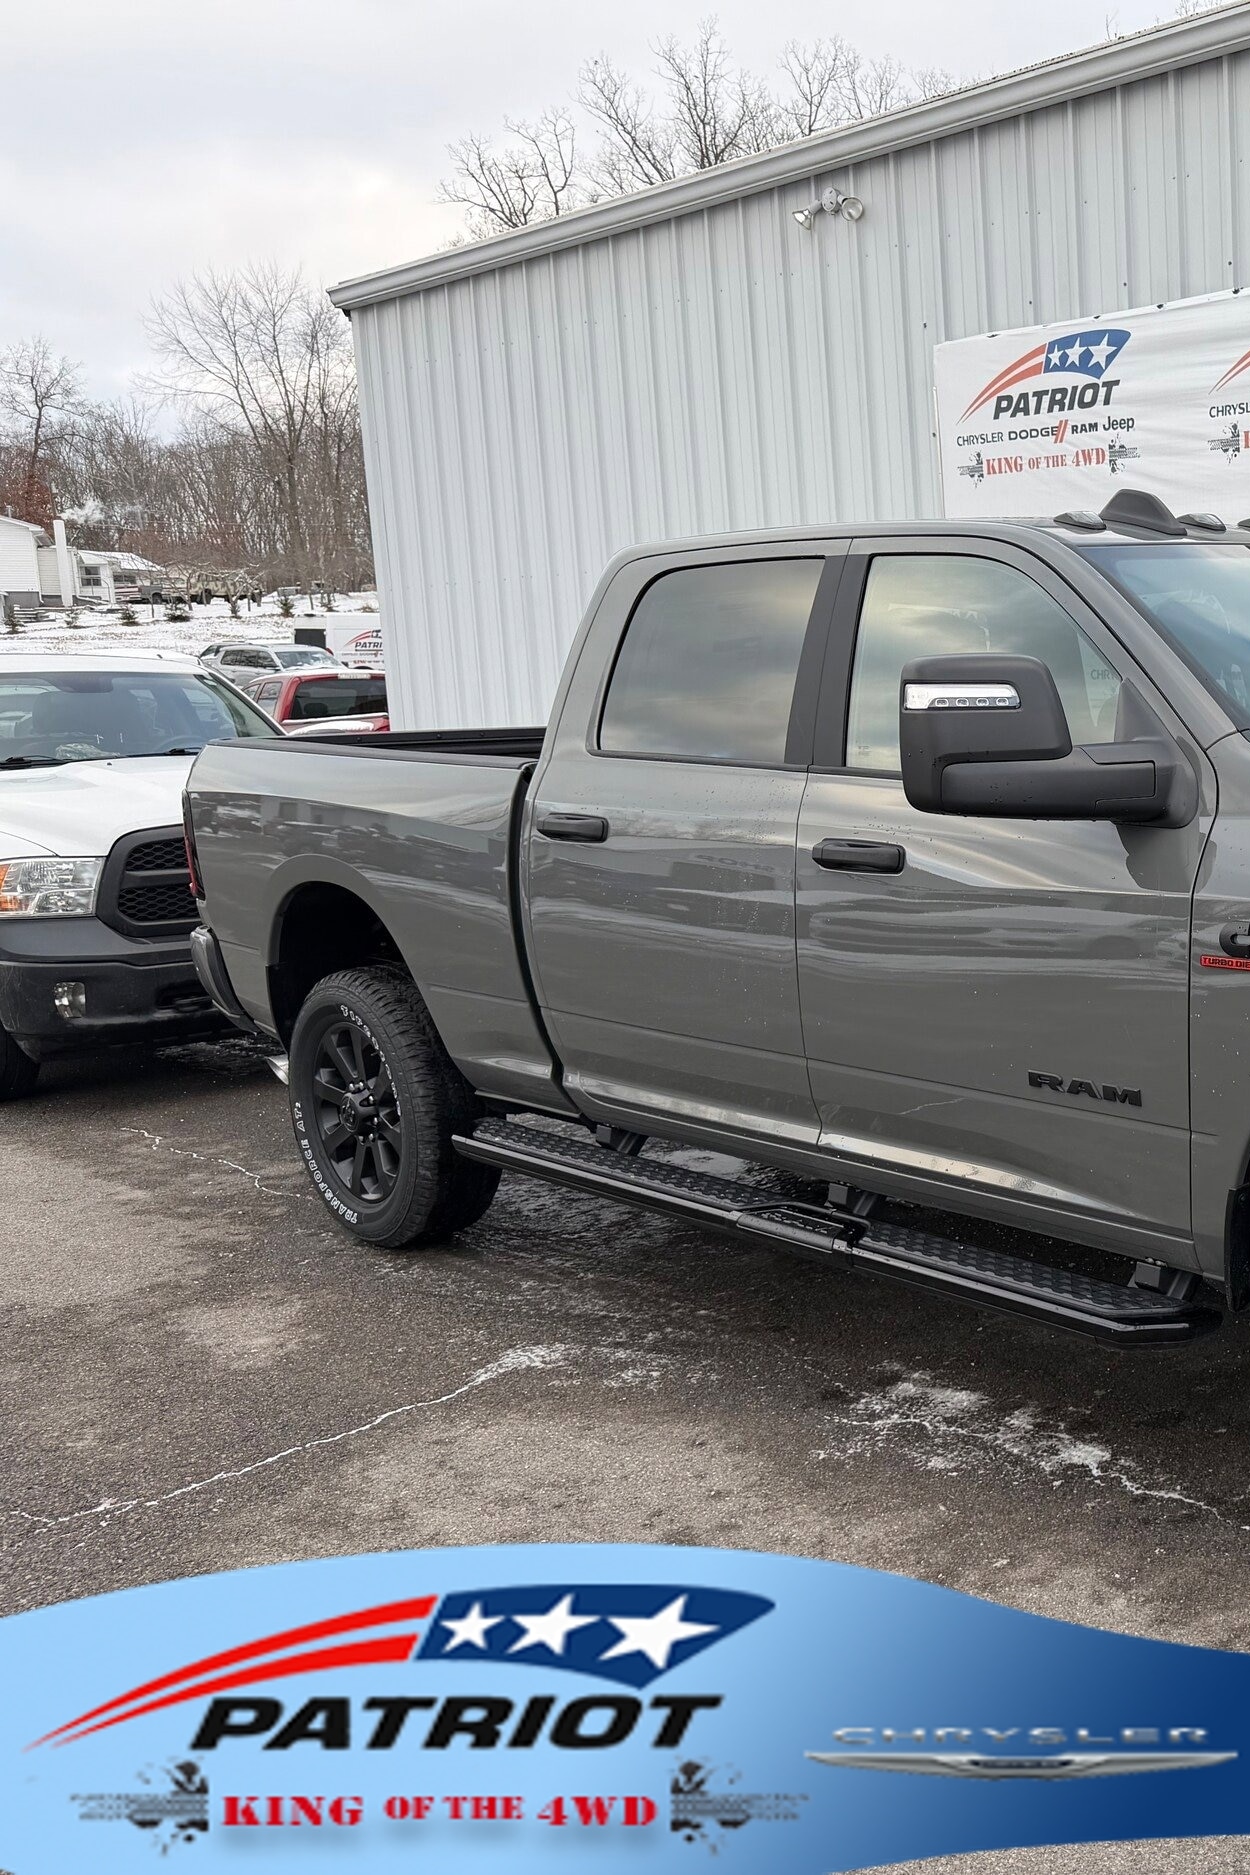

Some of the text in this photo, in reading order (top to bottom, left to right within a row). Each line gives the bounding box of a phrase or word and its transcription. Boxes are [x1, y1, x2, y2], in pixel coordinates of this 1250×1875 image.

[993, 379, 1121, 420] PATRIOT
[956, 416, 1135, 447] CHRYSLER DODGE RAM Jeep
[985, 447, 1106, 475] KING OF THE 4WD
[1202, 956, 1234, 968] TURBO
[1027, 1069, 1143, 1107] RAM
